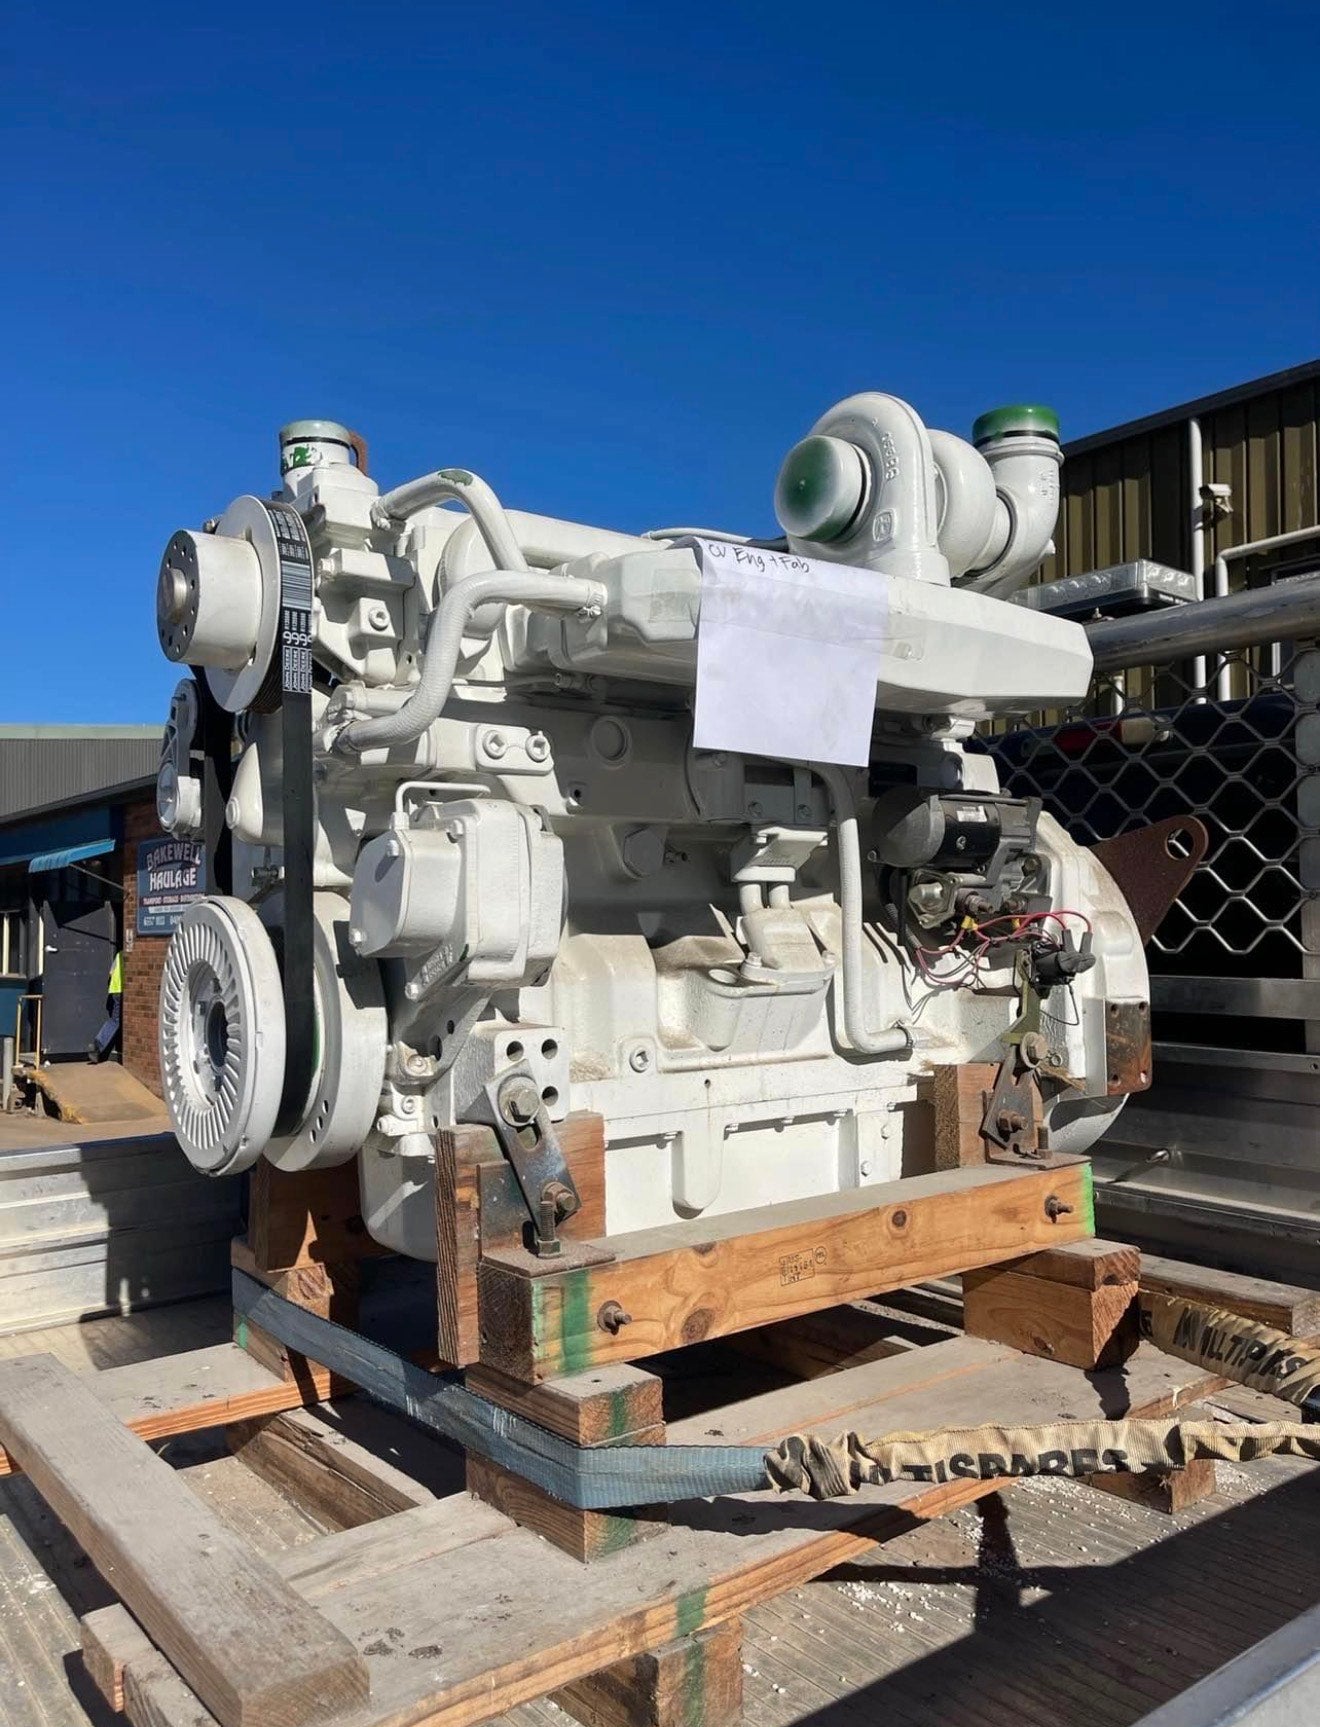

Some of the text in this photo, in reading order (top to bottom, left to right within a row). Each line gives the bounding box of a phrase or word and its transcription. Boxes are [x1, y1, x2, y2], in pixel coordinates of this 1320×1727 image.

[732, 547, 765, 572] Eng
[779, 555, 810, 573] Fab
[147, 843, 200, 871] BAKEWELL
[150, 868, 196, 891] HAULAGE
